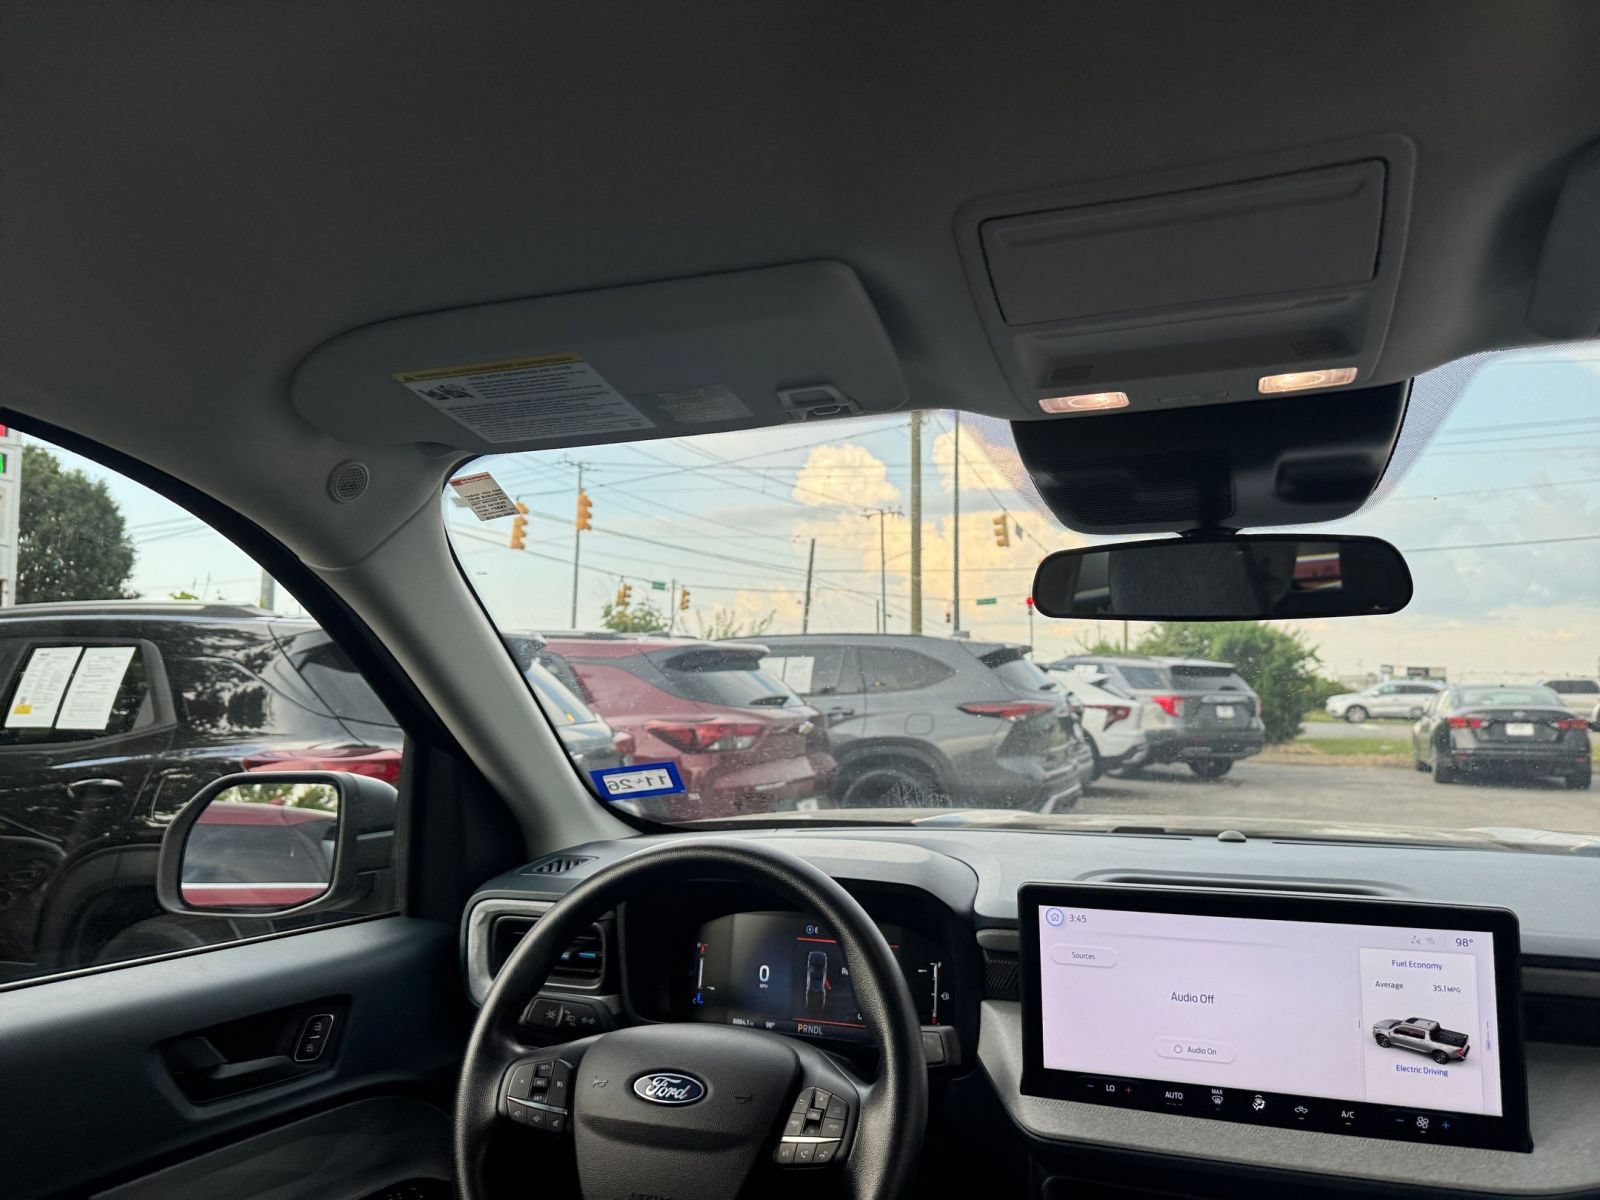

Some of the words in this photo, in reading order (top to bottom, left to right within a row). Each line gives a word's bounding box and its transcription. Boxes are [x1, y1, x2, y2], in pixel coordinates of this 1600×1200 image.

[1069, 914, 1087, 923] 3:45
[1455, 937, 1474, 947] 98°
[1071, 951, 1096, 961] Sources
[1391, 959, 1407, 968] Fuel
[1409, 960, 1443, 971] Economy
[759, 964, 770, 982] 0
[1375, 980, 1404, 990] Average
[1170, 991, 1198, 1003] Audio
[1199, 993, 1215, 1004] Off
[1187, 1046, 1206, 1054] Audio
[1206, 1047, 1217, 1056] On
[1395, 1064, 1423, 1074] Electric
[1422, 1066, 1449, 1078] Driving
[645, 1076, 691, 1100] Ford
[1164, 1091, 1184, 1100] AUTO
[1341, 1110, 1355, 1119] A/C
